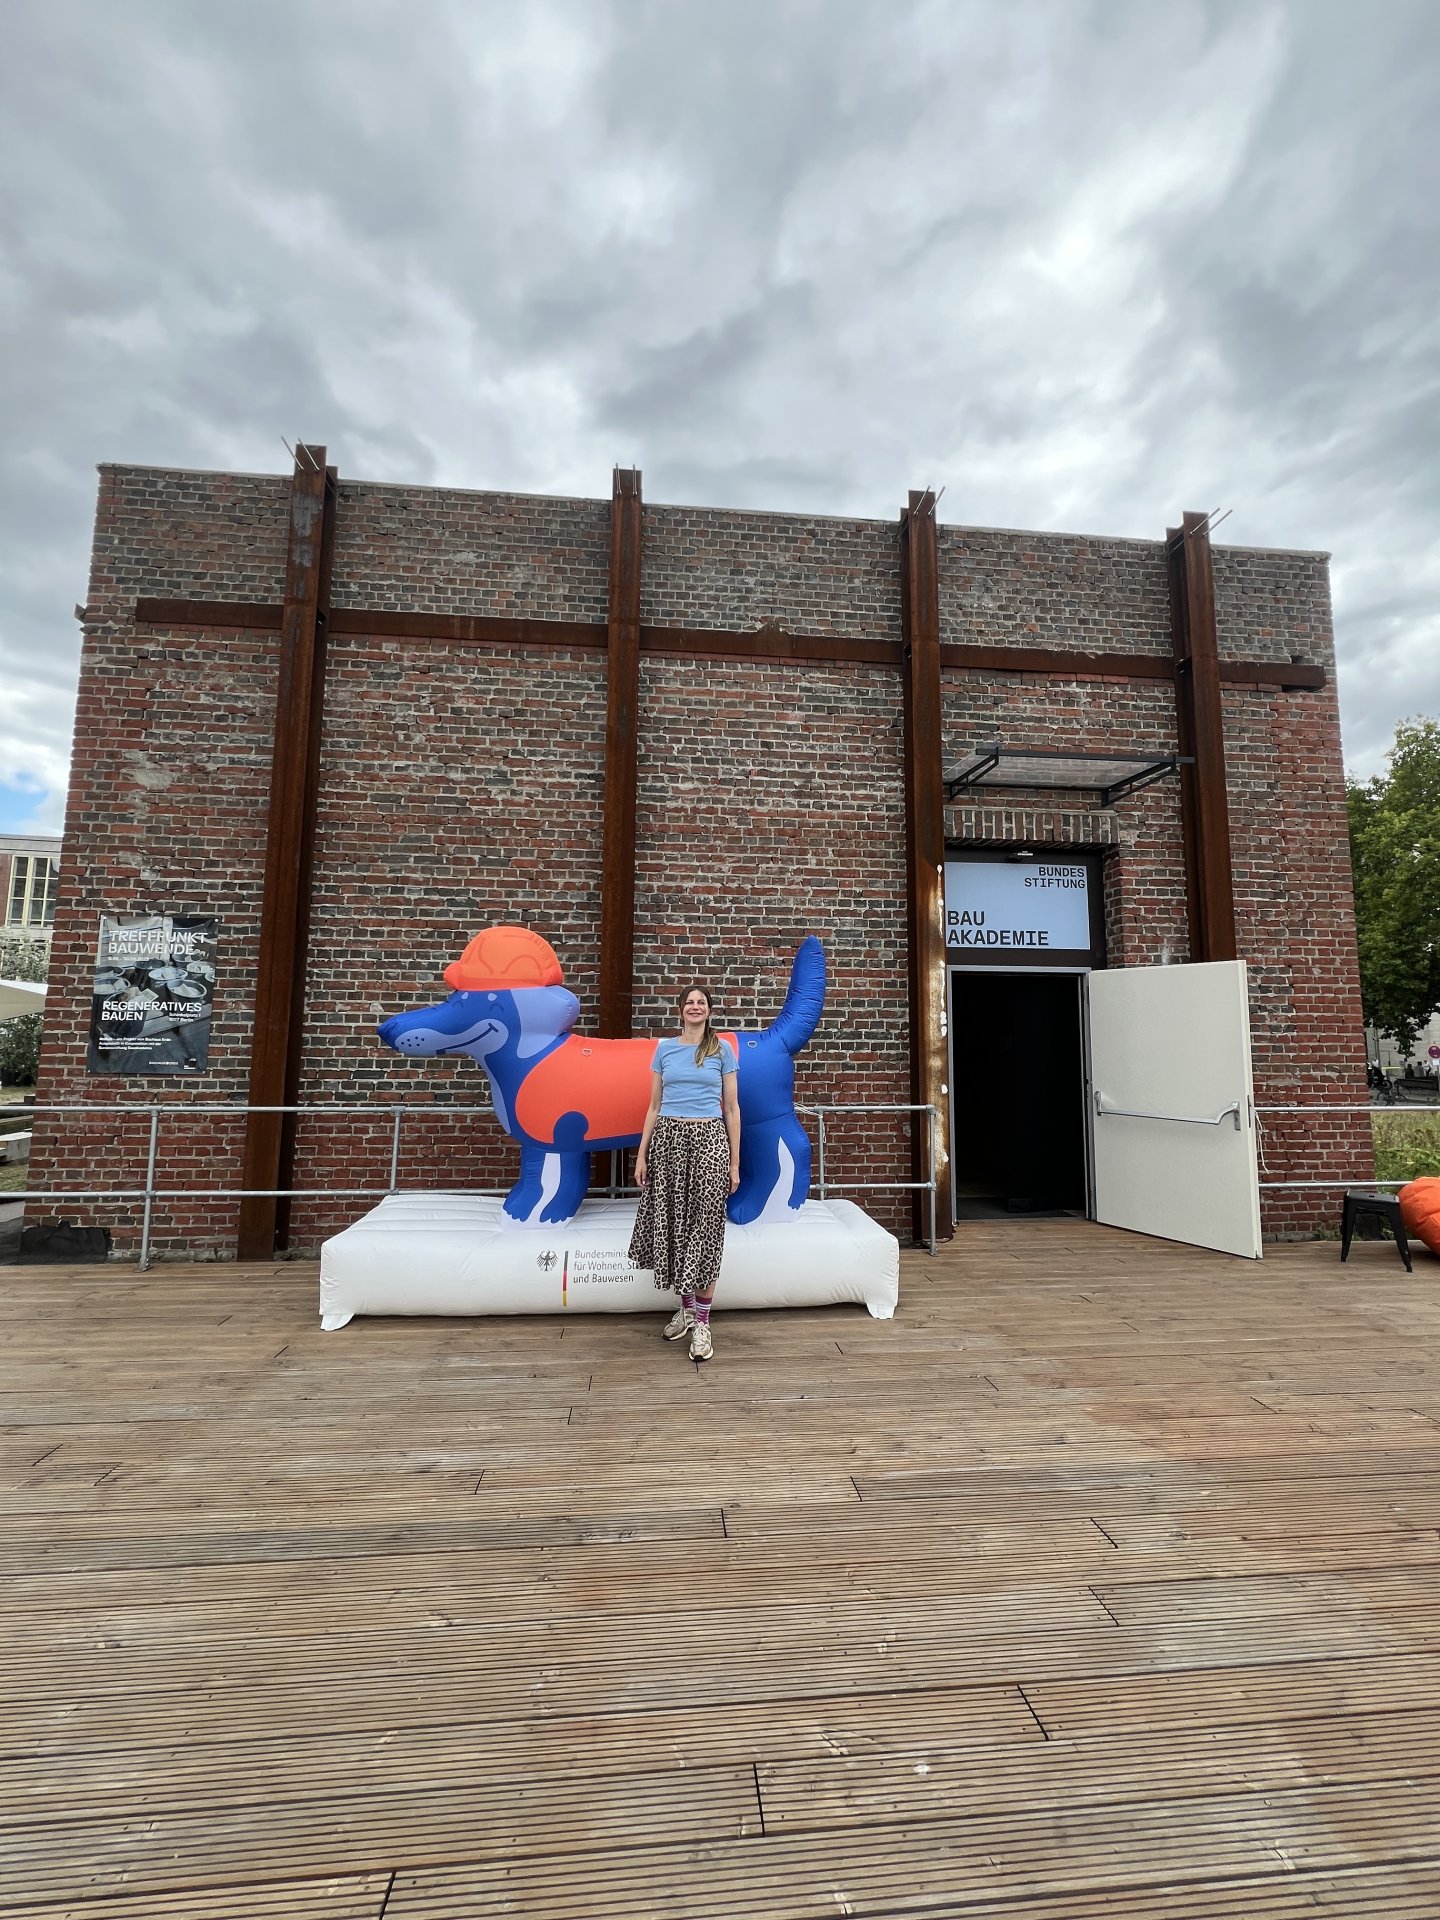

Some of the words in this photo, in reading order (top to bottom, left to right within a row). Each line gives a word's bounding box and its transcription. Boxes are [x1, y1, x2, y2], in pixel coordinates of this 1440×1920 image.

[1038, 866, 1085, 878] BUNDES
[1024, 877, 1086, 889] STIFTUNG
[947, 910, 985, 926] BAU
[109, 930, 208, 944] TREFFPUNKT
[947, 929, 1049, 946] AKADEMIE
[108, 942, 195, 955] BAUWENDE
[102, 1000, 202, 1012] REGENERATIVES
[101, 1011, 144, 1021] BAUEN
[574, 1249, 629, 1259] Bundesminis
[573, 1260, 586, 1271] für
[588, 1261, 625, 1271] Wohnen,
[627, 1261, 639, 1270] St
[573, 1273, 590, 1284] und
[592, 1273, 634, 1283] Bauwesen
